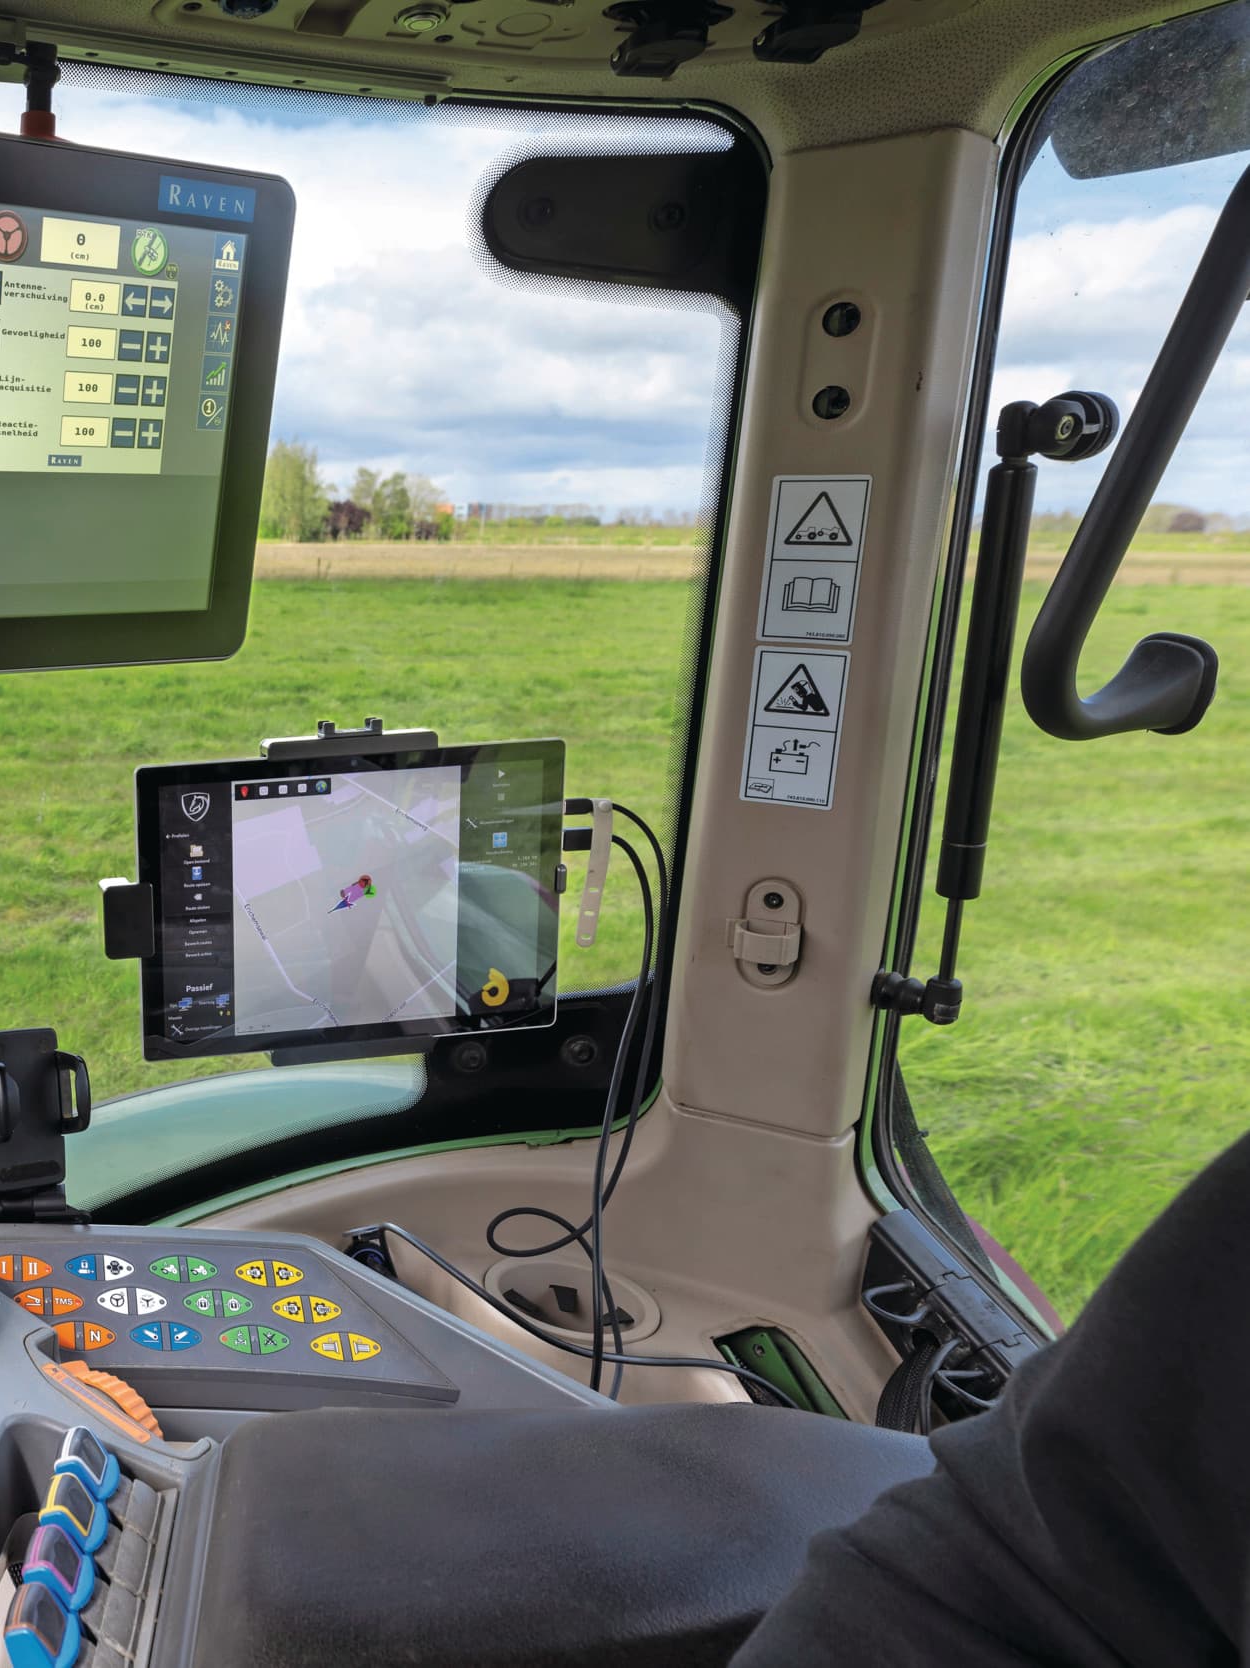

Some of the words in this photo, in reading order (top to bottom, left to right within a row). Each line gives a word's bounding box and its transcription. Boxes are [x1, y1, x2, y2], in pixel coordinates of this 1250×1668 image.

[168, 183, 246, 215] RAVEN
[76, 233, 86, 246] 0
[70, 251, 90, 262] (cm)
[4, 280, 47, 291] Antenne-
[4, 290, 68, 303] verschuiving
[85, 292, 106, 303] 0.0
[1, 328, 66, 340] Gevoeligheid
[81, 338, 102, 348] 100
[77, 383, 99, 393] 100
[74, 427, 95, 437] 100
[50, 456, 79, 466] RAVEN
[185, 983, 214, 993] Passief
[55, 1297, 73, 1306] TMS
[90, 1330, 101, 1342] N
